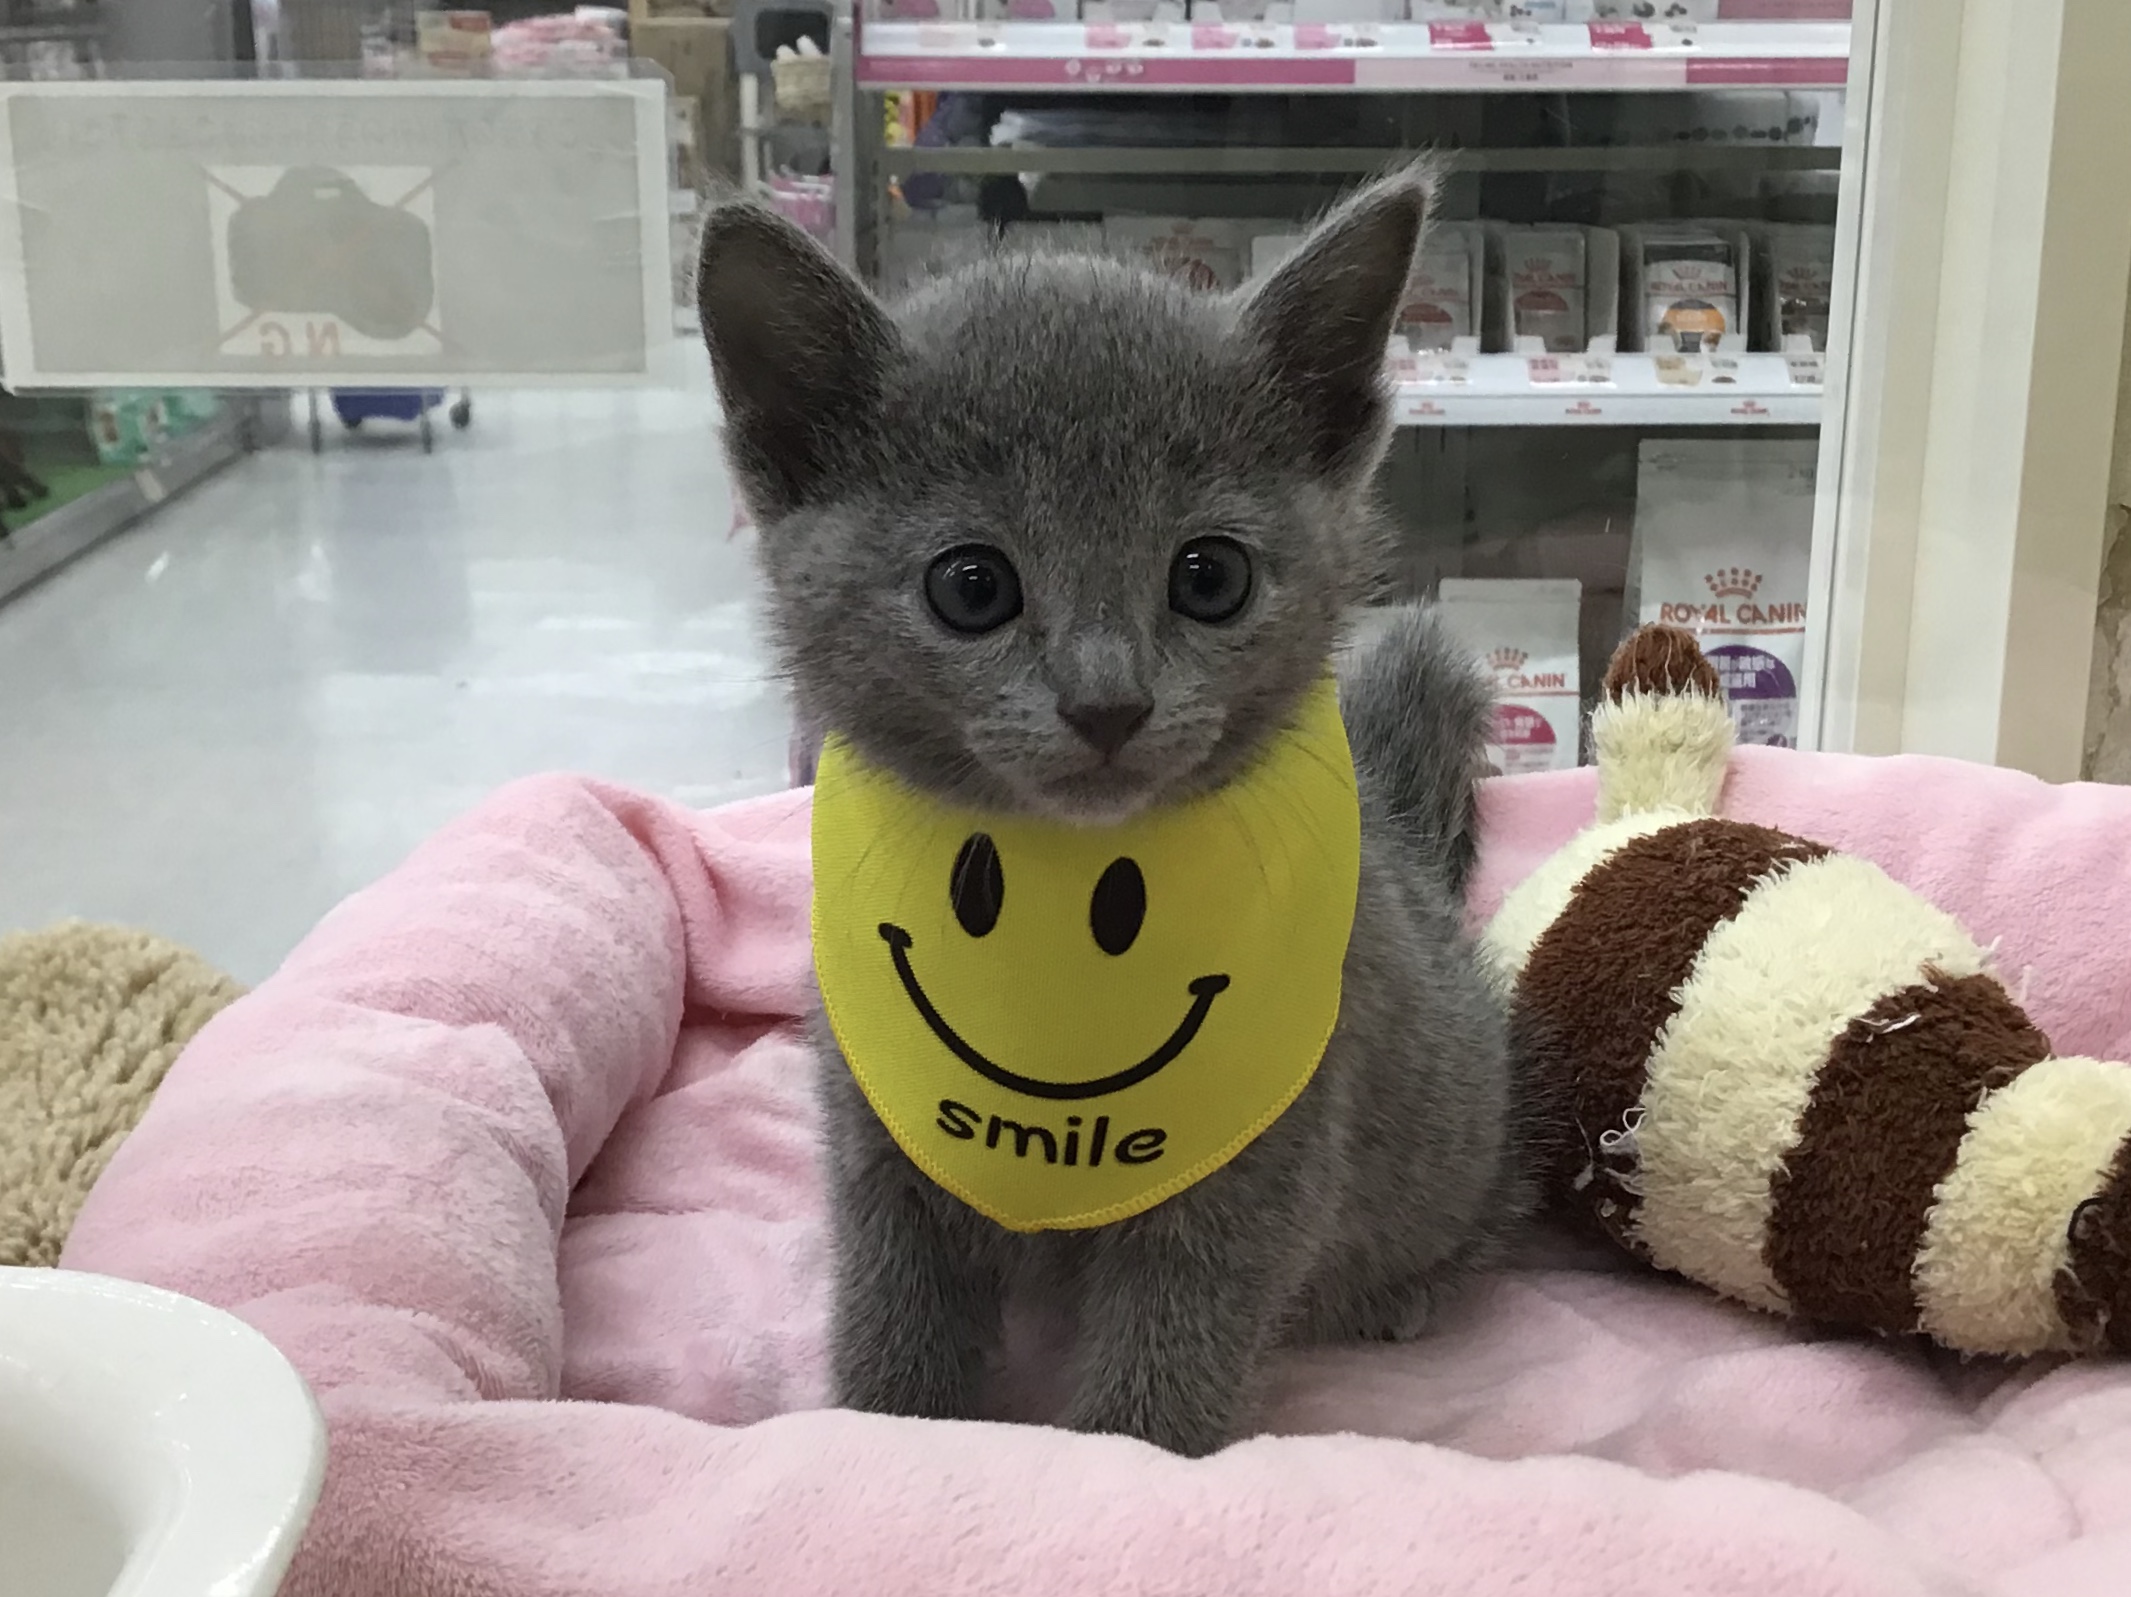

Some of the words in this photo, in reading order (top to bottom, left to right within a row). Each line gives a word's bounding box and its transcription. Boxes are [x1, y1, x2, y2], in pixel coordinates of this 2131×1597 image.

[1660, 602, 1731, 624] ROYAL
[1508, 673, 1566, 689] CANIN
[936, 1099, 1168, 1167] smile
